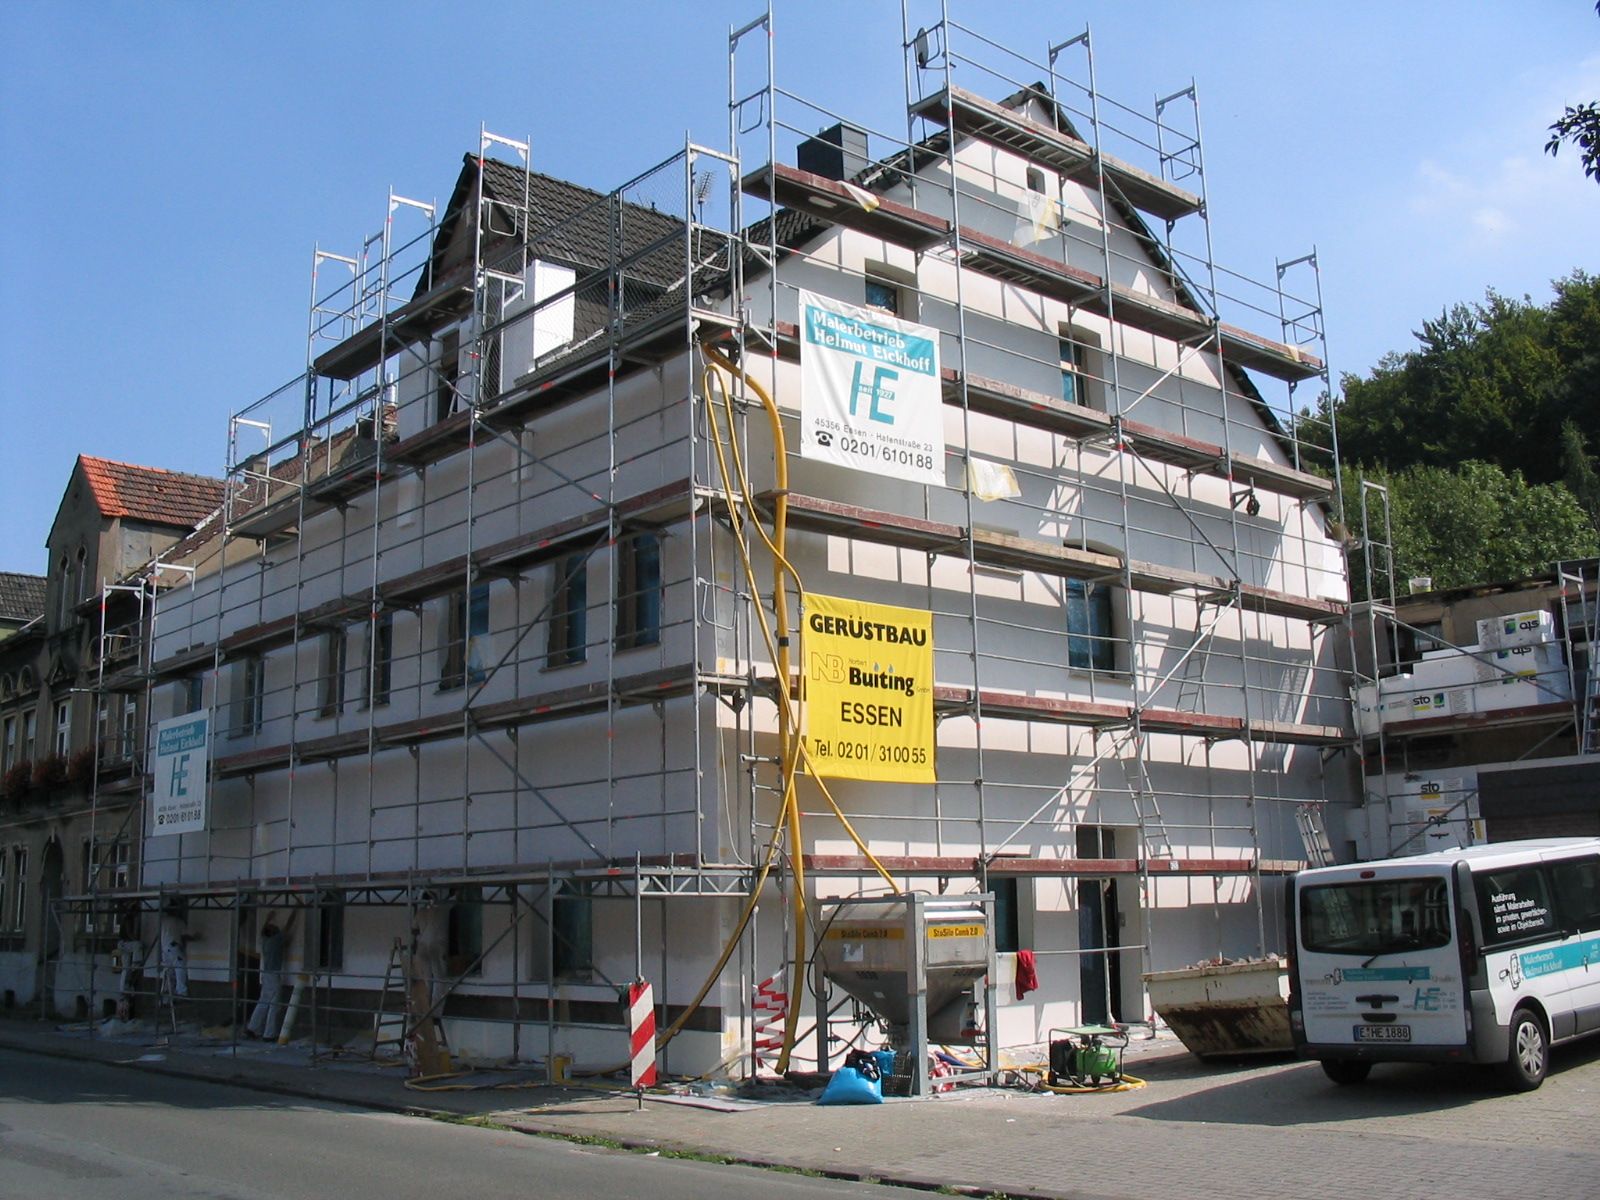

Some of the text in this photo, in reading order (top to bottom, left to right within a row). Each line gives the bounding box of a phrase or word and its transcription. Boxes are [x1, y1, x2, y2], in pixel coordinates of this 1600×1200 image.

[813, 310, 905, 349] Malerbetrieb
[814, 327, 931, 372] Helmut Eickhoff
[849, 361, 899, 425] HE
[876, 388, 893, 399] 1927
[815, 418, 840, 431] 45356
[844, 425, 867, 438] Essen
[876, 432, 921, 449] Hafenstraße
[924, 443, 933, 452] 23
[841, 437, 933, 470] 0201/610188
[810, 613, 926, 647] GERÜSTBAU
[811, 652, 846, 684] NB
[849, 666, 915, 697] Buiting
[841, 701, 902, 727] ESSEN
[814, 739, 833, 757] Tel.
